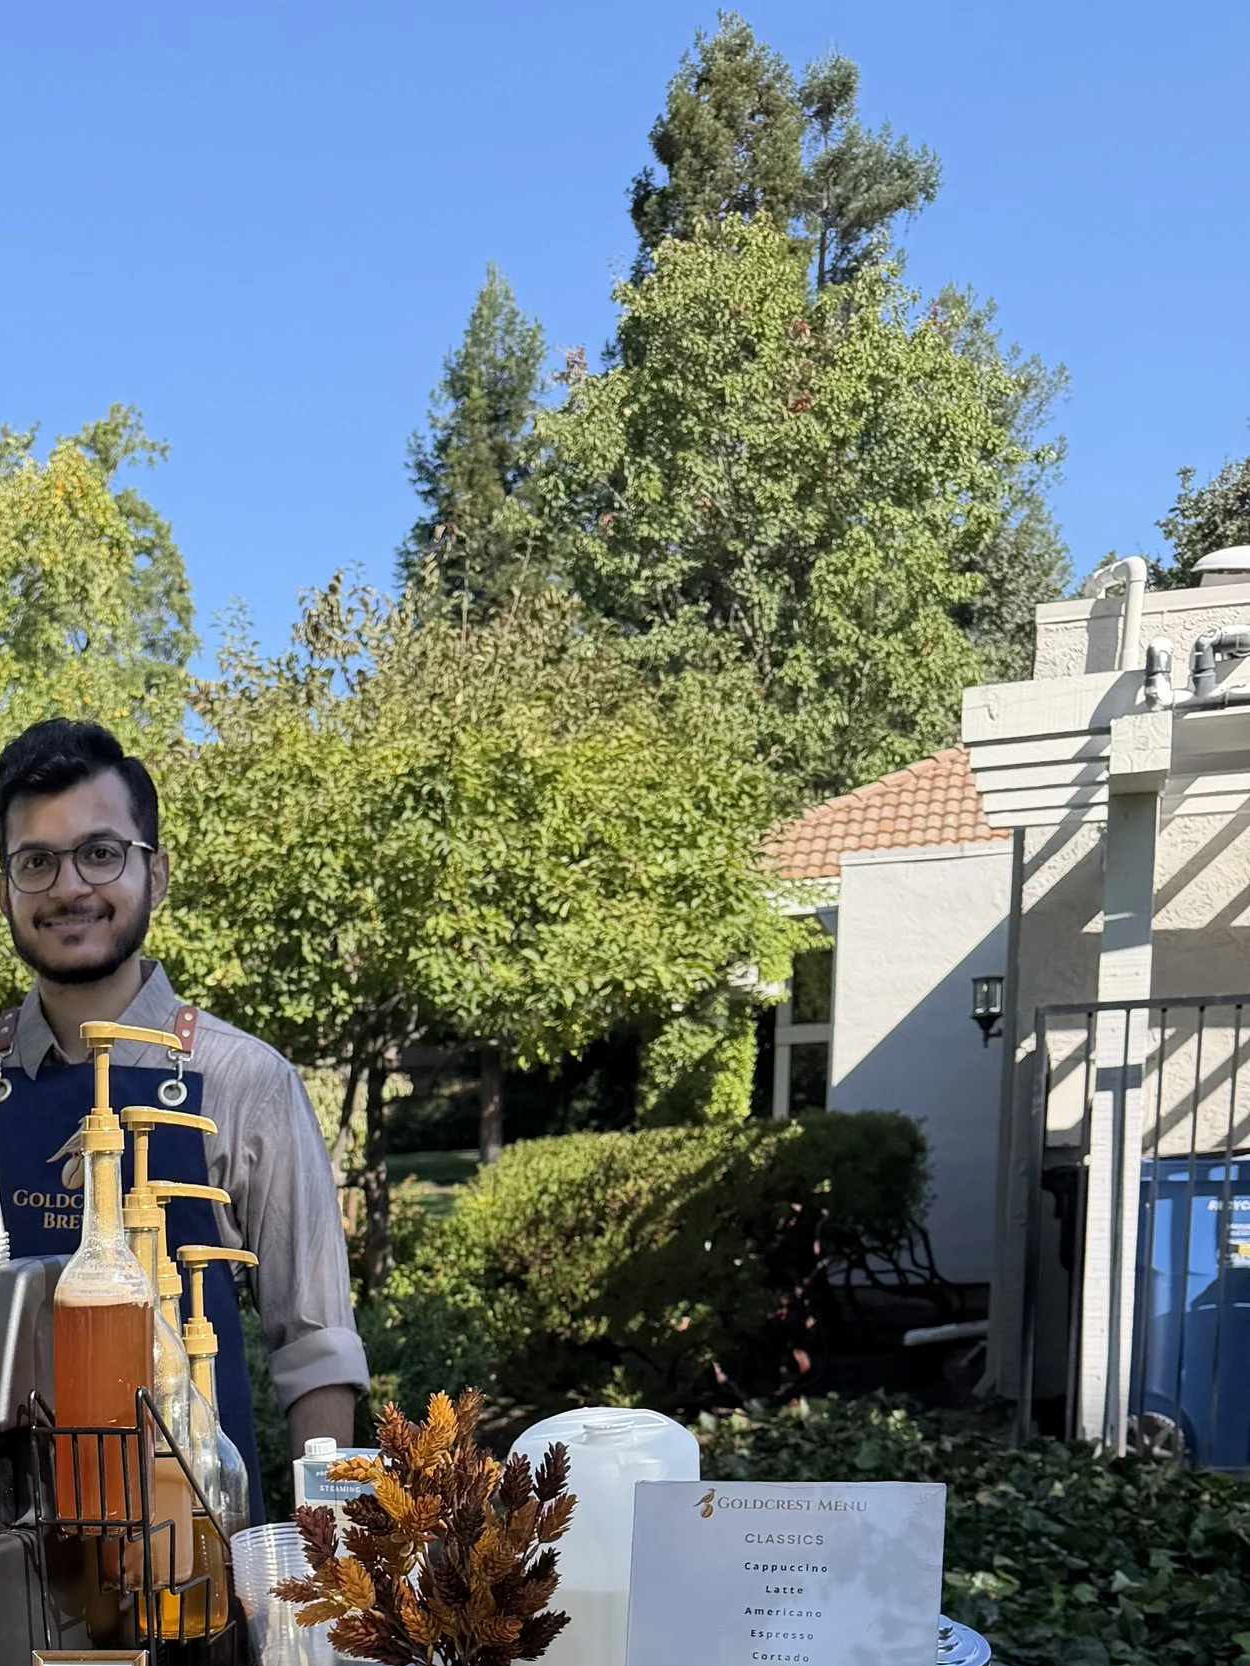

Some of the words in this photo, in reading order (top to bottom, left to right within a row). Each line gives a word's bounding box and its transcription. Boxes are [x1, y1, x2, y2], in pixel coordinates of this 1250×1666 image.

[13, 1189, 84, 1208] GOLDC
[43, 1212, 84, 1229] BRE
[319, 1485, 361, 1493] STEAMING
[717, 1496, 812, 1511] GOLDCREST
[818, 1499, 867, 1512] MENU
[744, 1533, 824, 1545] CLASSICS
[744, 1562, 828, 1573] Cappuccino
[765, 1585, 804, 1595] Latte
[744, 1607, 822, 1618] Americano
[750, 1629, 814, 1640] Espresso
[752, 1651, 809, 1663] Cortado
